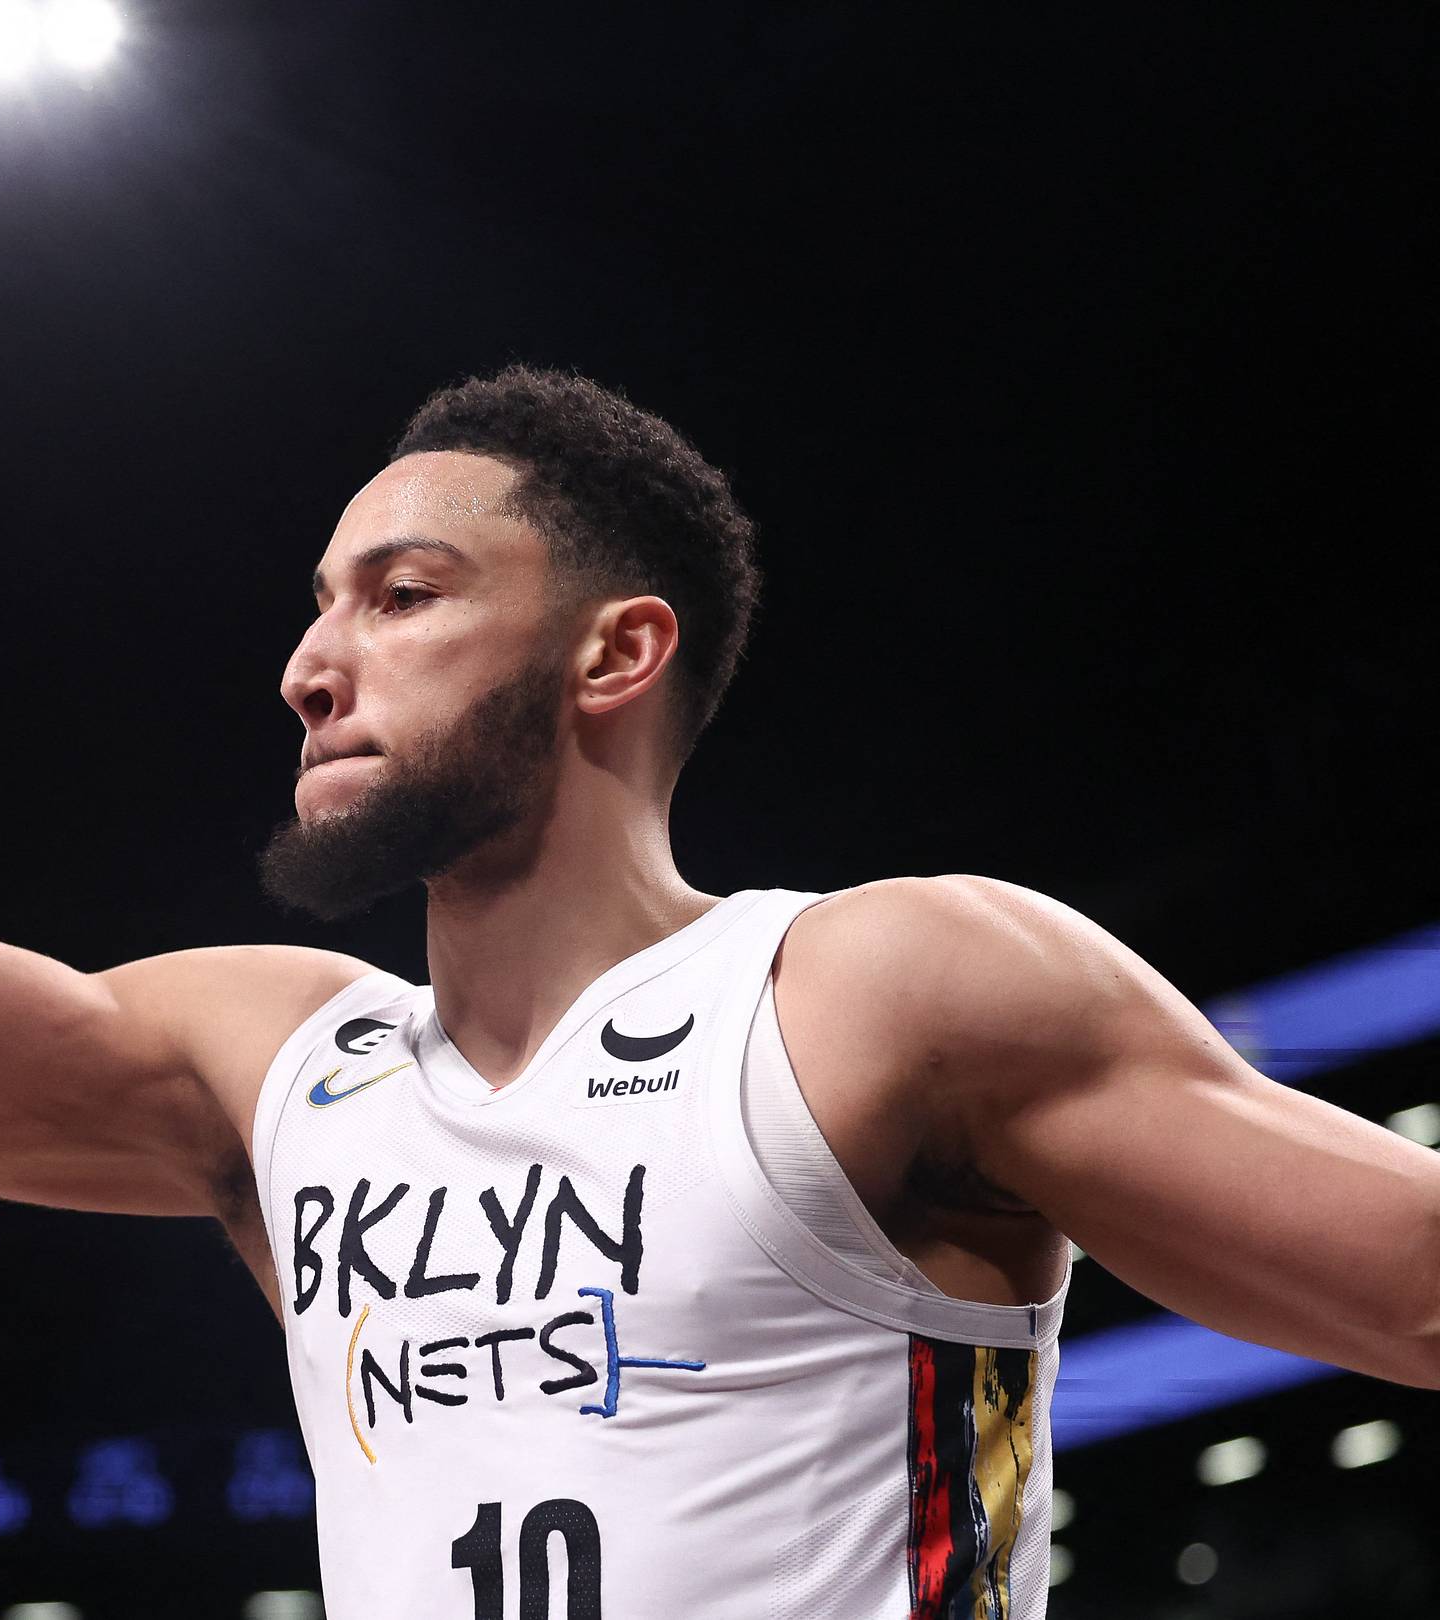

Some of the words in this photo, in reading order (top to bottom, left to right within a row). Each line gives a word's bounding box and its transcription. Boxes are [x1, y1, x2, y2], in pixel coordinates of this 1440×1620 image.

[587, 1070, 680, 1099] Webull
[293, 1163, 647, 1319] BKLYN
[451, 1498, 602, 1620] 10
